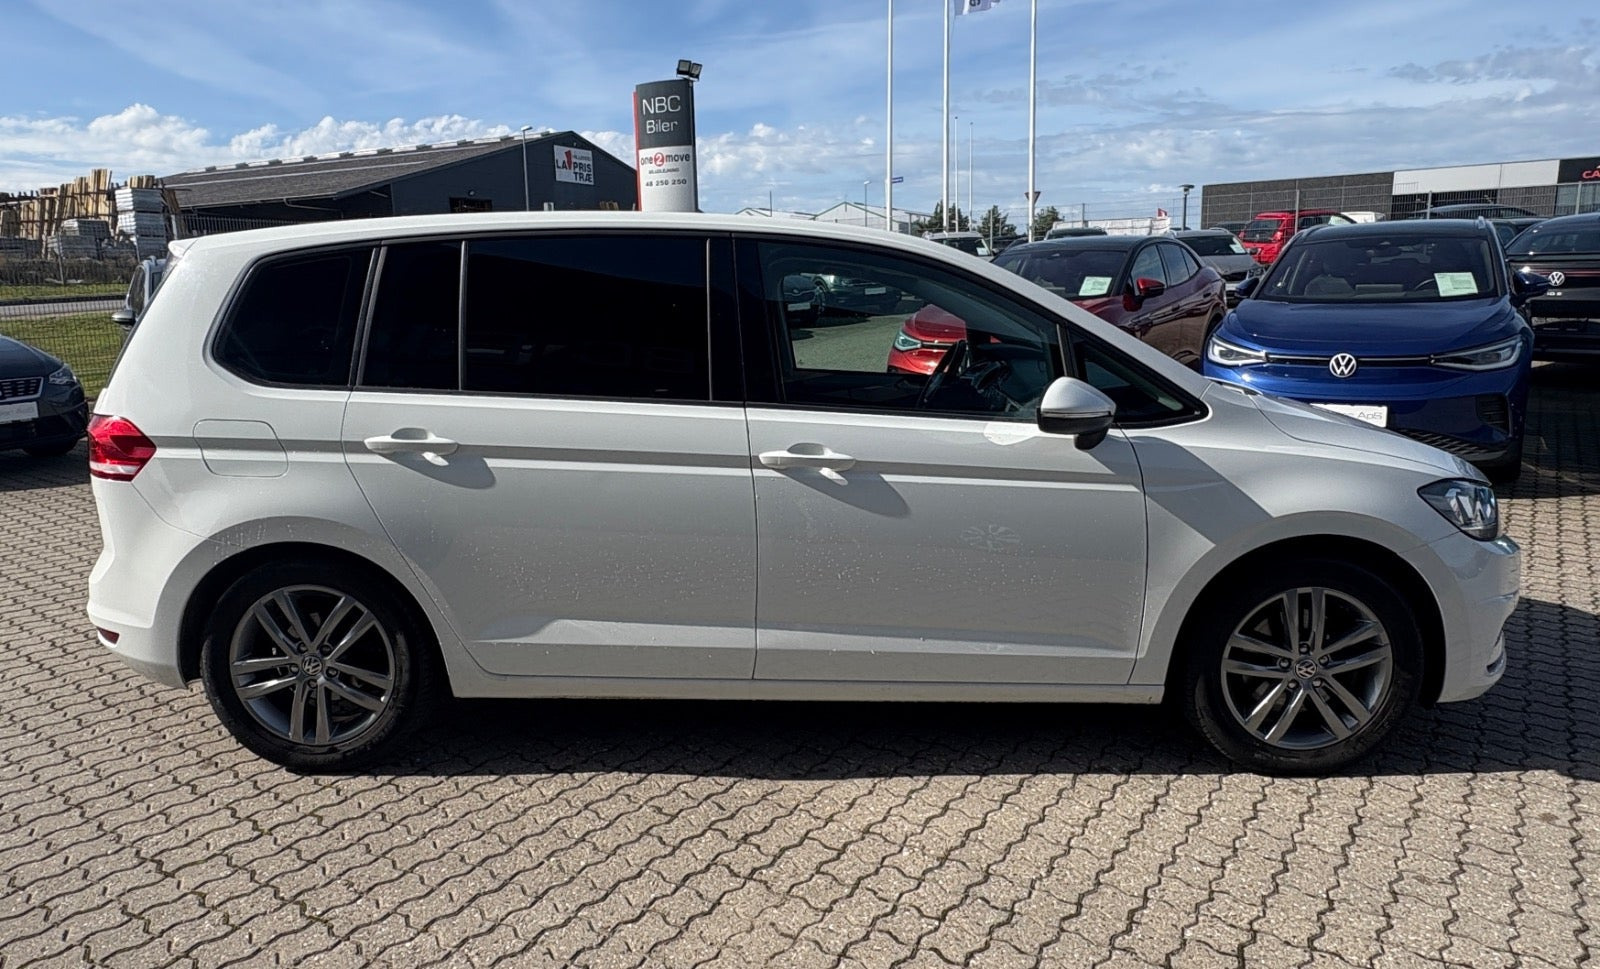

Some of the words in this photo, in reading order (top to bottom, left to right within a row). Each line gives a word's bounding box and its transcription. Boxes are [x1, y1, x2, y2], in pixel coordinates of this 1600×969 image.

[642, 95, 681, 116] NBC
[646, 119, 678, 134] Biler
[573, 171, 593, 183] TRÆ
[655, 179, 669, 187] 250
